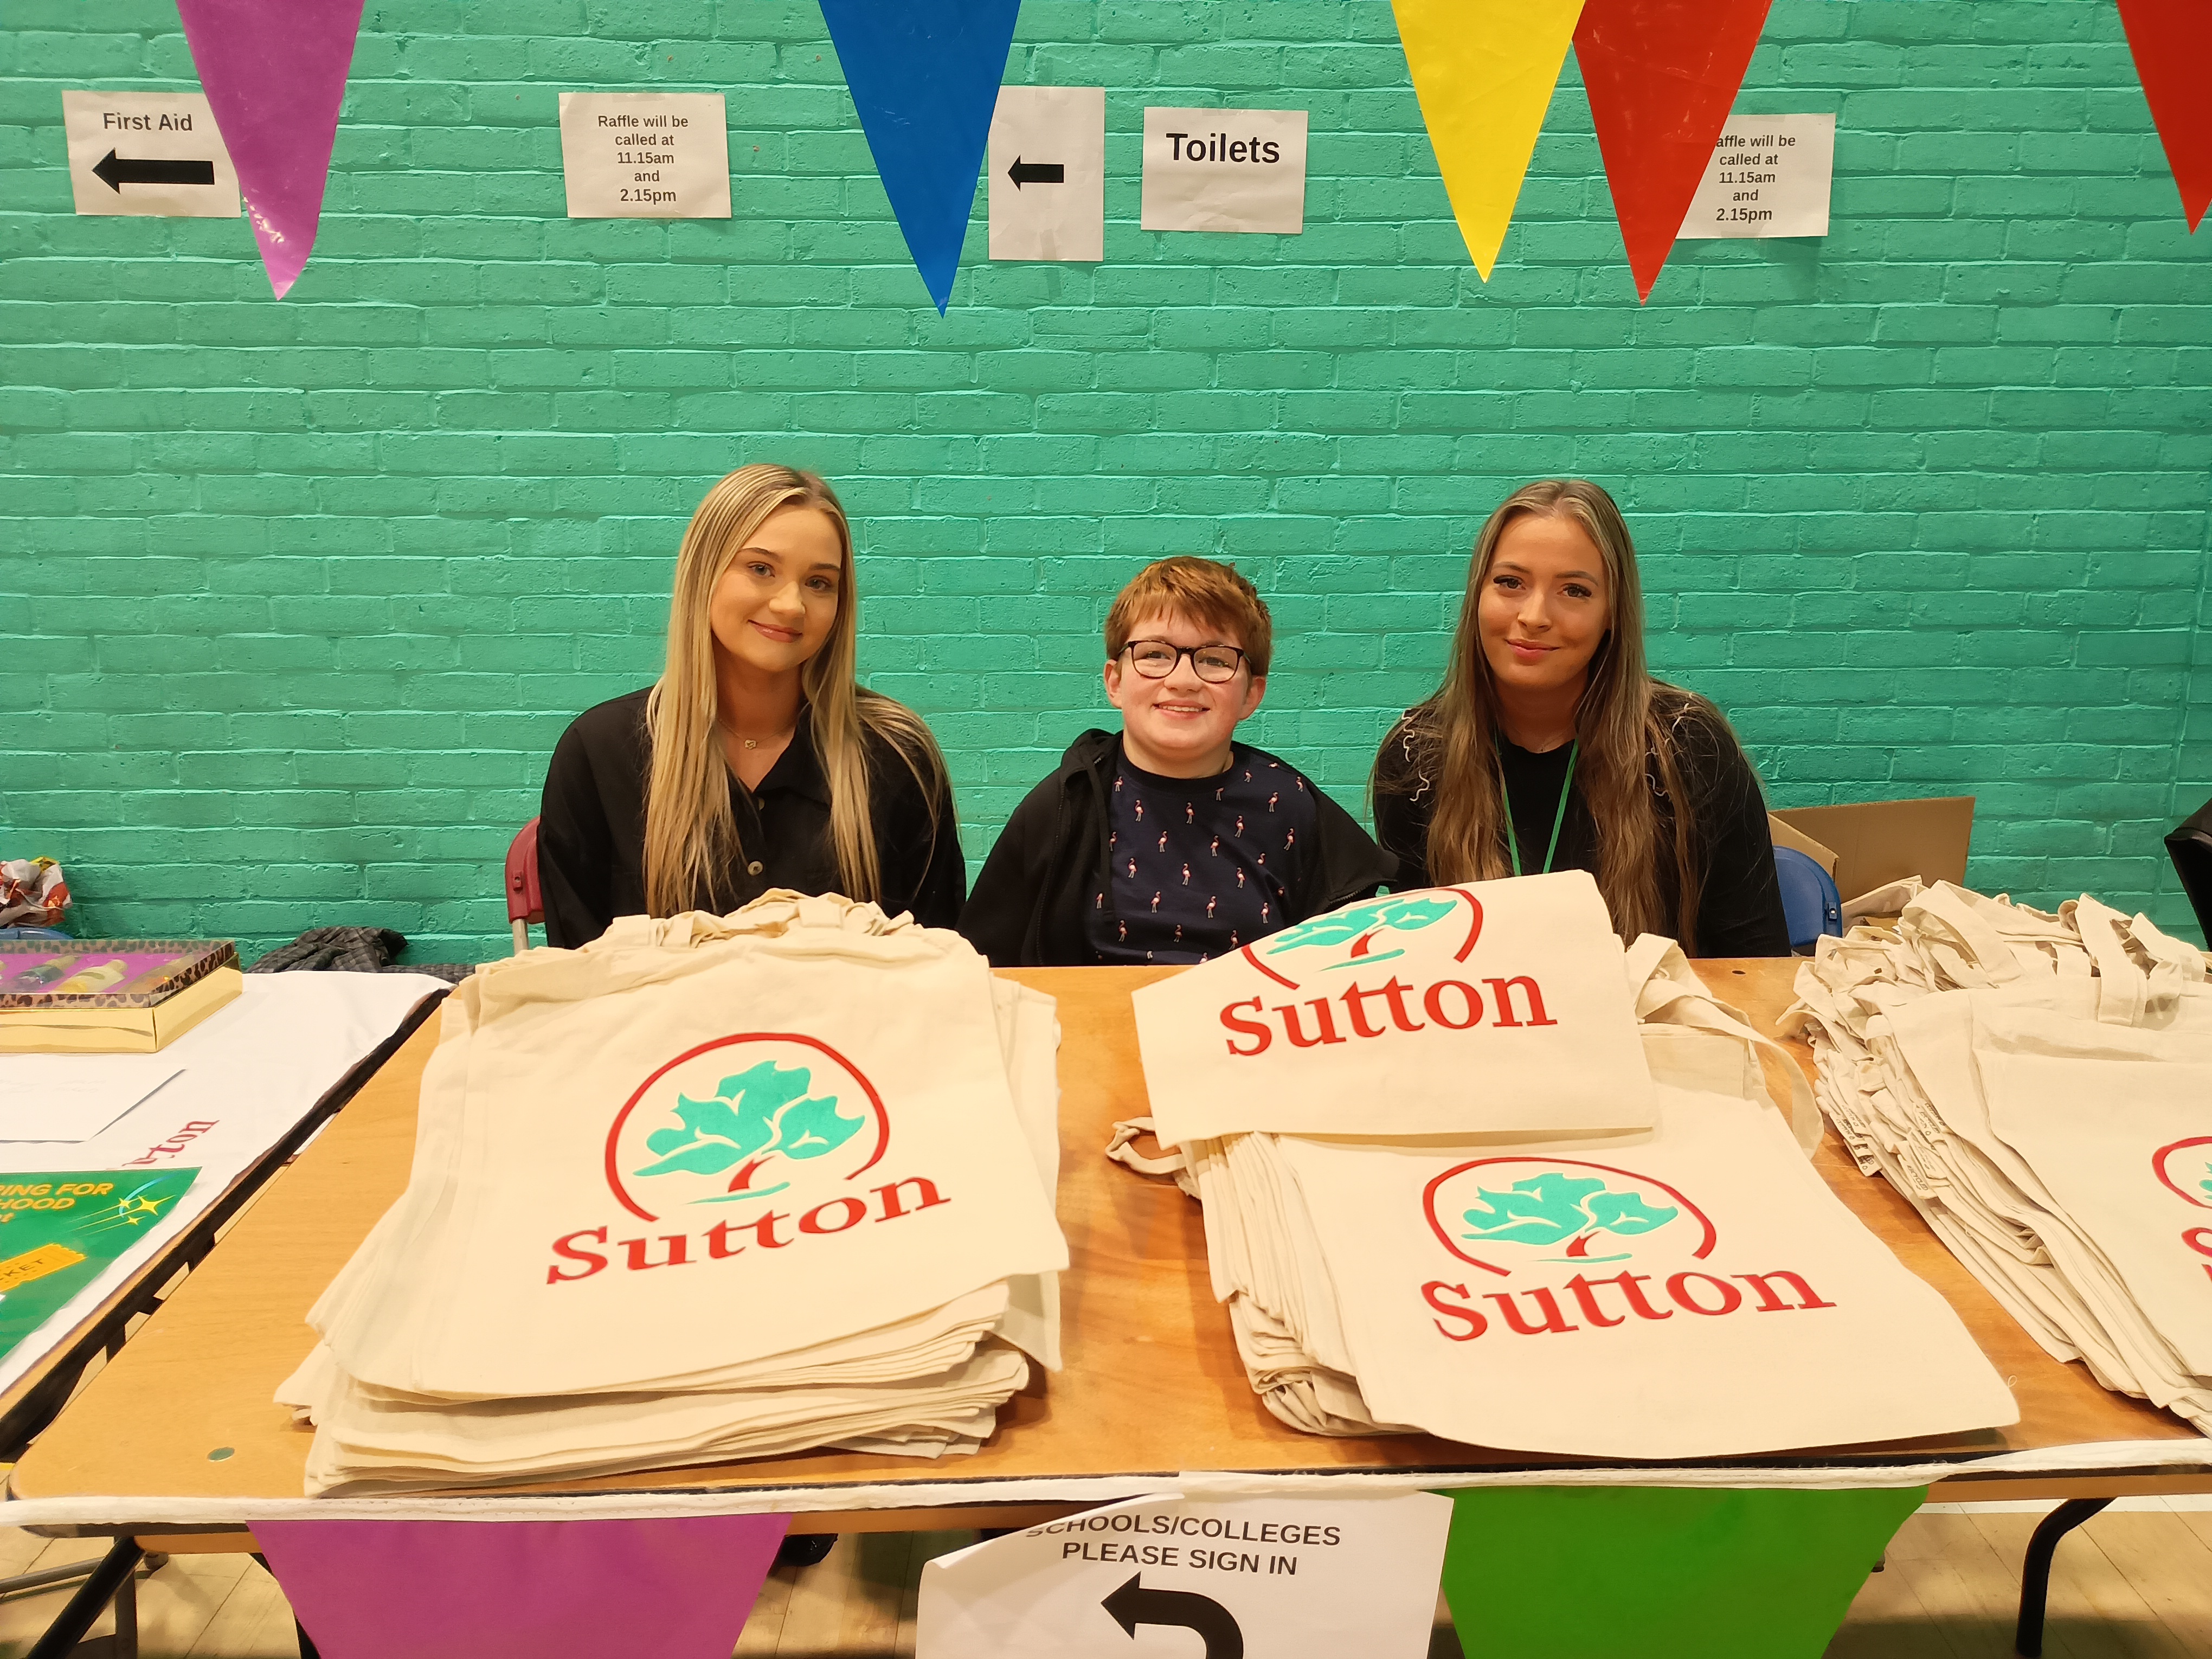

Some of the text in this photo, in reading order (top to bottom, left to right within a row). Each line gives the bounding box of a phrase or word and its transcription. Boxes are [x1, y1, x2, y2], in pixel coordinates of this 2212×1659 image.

[104, 112, 192, 131] First Aid
[597, 115, 689, 127] Raffle will be
[615, 133, 674, 146] called at
[1716, 135, 1796, 147] affle will be
[1166, 133, 1279, 163] Toilets
[617, 152, 674, 164] 11.15am
[1719, 153, 1778, 165] called at
[634, 170, 660, 182] and
[1719, 171, 1776, 183] 11.15am
[620, 188, 677, 205] 2.15pm
[1733, 189, 1759, 201] and
[1716, 208, 1772, 224] 2.15pm
[1220, 975, 1558, 1056] Sutton
[55, 1182, 114, 1195] FOR
[546, 1176, 951, 1285] Sutton
[1420, 1270, 1837, 1341] Sutton
[1062, 1542, 1297, 1576] PLEASE SIGN IN
